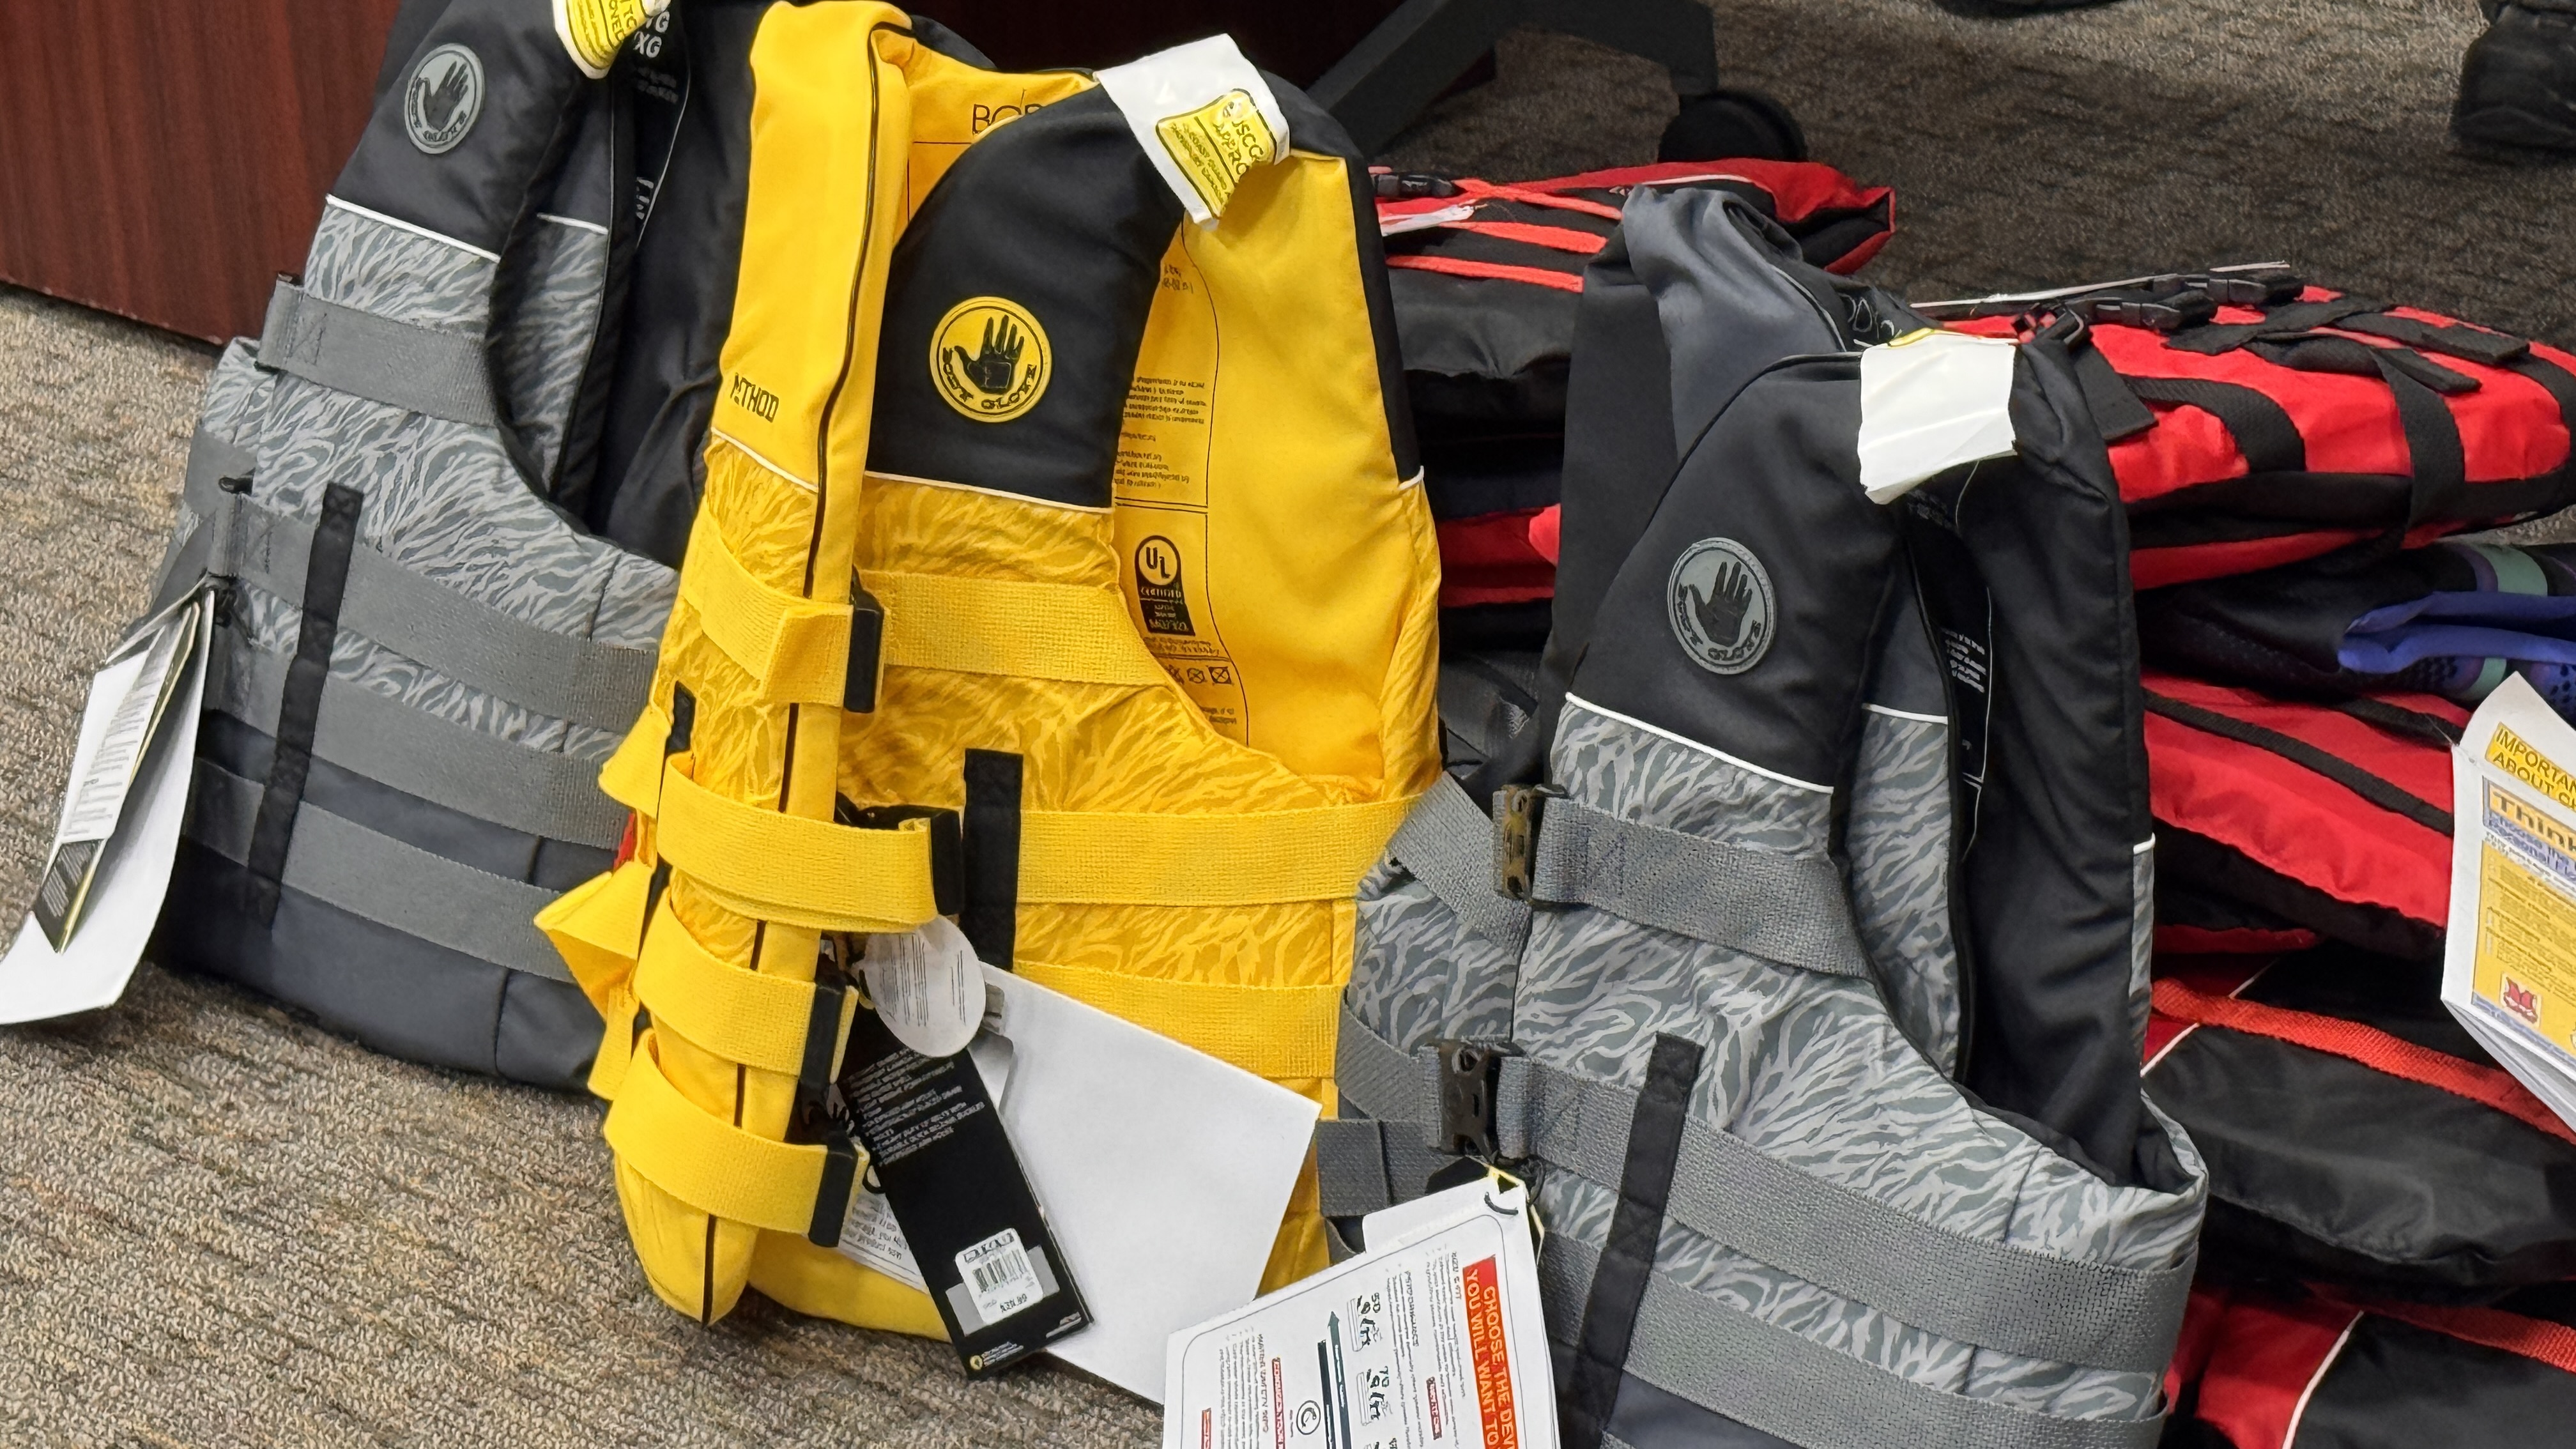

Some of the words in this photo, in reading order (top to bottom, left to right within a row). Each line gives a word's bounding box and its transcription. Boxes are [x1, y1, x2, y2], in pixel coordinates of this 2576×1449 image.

[1146, 546, 1171, 579] UL
[2494, 751, 2554, 795] ABOUT
[1371, 1292, 1381, 1313] 50
[1466, 1269, 1481, 1310] YOU
[1471, 1311, 1487, 1361] WILL
[1483, 1285, 1505, 1365] CHOOSE
[1494, 1366, 1510, 1407] THE
[1477, 1360, 1496, 1413] WANT
[1485, 1418, 1499, 1445] TO
